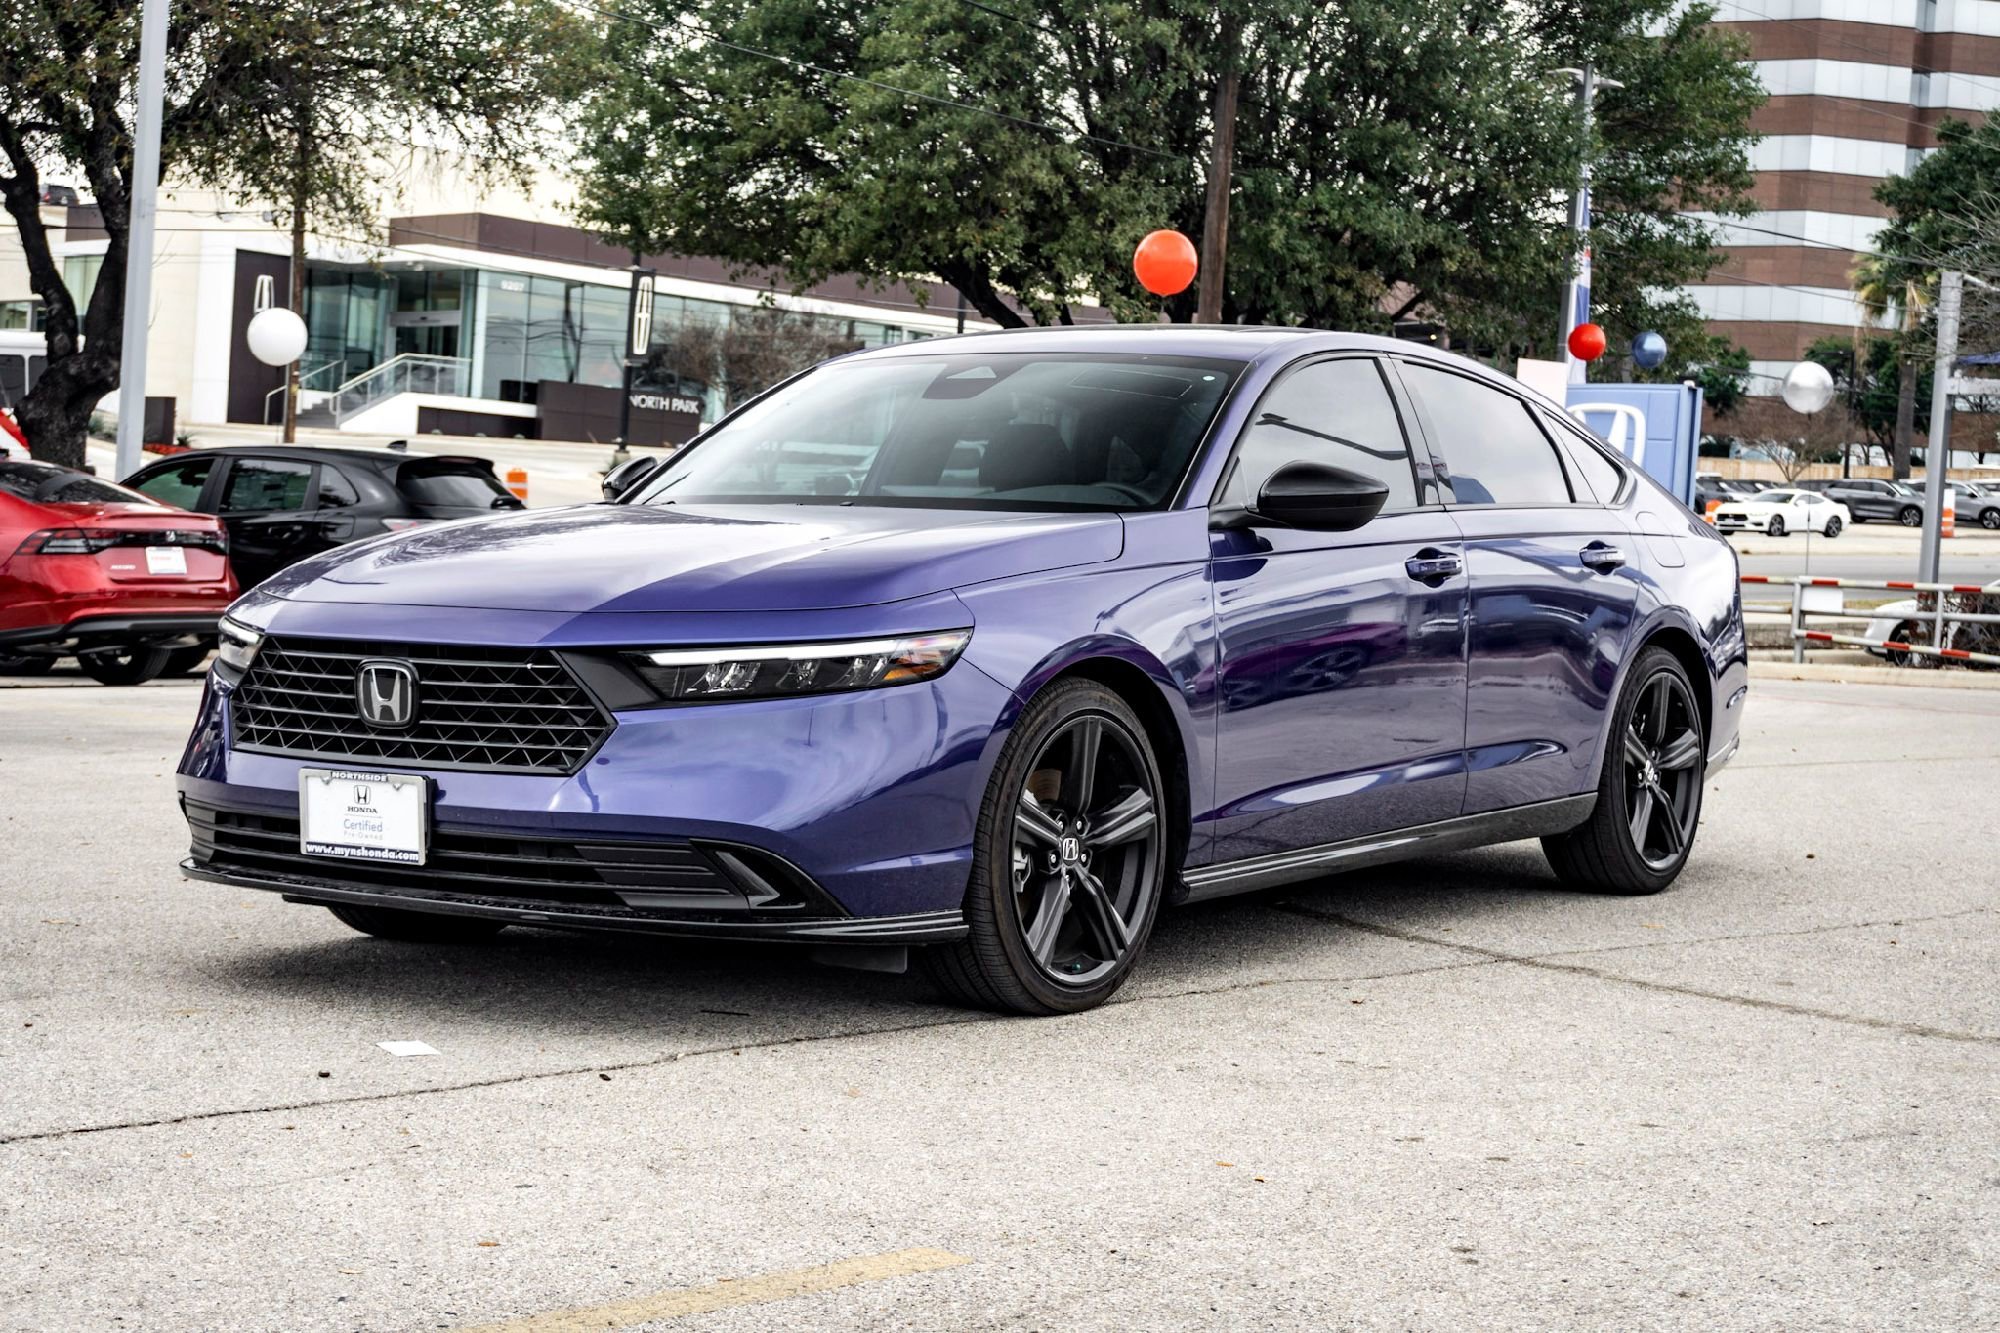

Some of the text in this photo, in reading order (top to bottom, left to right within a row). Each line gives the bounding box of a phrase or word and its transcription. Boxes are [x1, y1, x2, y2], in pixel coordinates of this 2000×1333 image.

[629, 395, 699, 414] NORTH PARK
[331, 771, 388, 782] NORTHSIDE
[347, 806, 378, 814] HONDA
[343, 819, 383, 832] Certified
[306, 844, 419, 860] www.mynshonda.com
